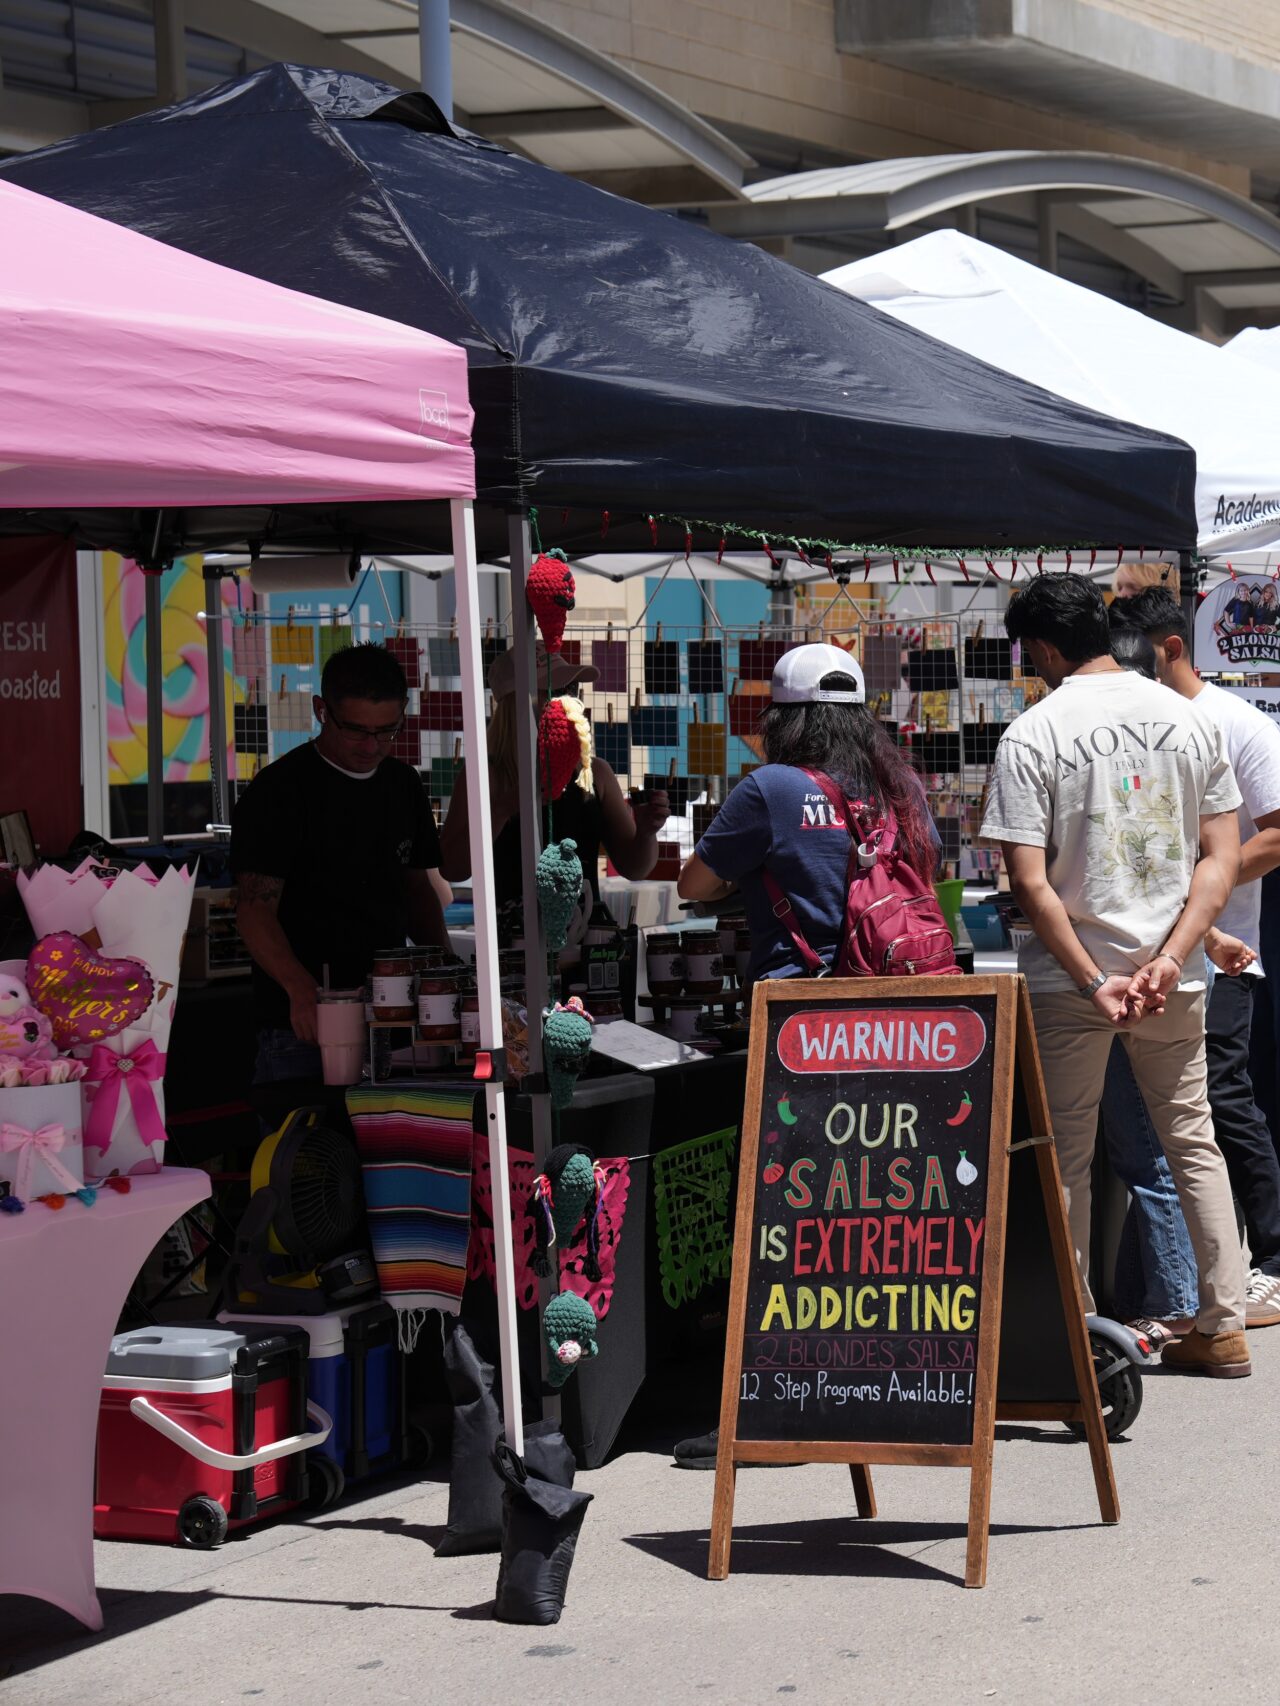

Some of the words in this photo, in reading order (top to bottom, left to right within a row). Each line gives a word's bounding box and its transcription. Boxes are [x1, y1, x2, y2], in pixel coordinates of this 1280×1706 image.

[0, 621, 47, 652] ESH
[1219, 641, 1230, 651] 2
[1230, 647, 1280, 662] SALSA
[0, 669, 61, 700] oasted
[1055, 722, 1202, 782] MONZA
[1114, 758, 1146, 771] ITALY
[72, 956, 116, 977] HAPPY
[53, 1016, 80, 1032] DAY
[798, 1021, 957, 1062] WARNING
[825, 1102, 919, 1149] OUR
[784, 1155, 950, 1211] SALSA
[759, 1225, 788, 1262] IS
[794, 1215, 986, 1276] EXTREMELY
[759, 1283, 977, 1332] ADDICTING
[754, 1337, 782, 1366] 2
[788, 1337, 896, 1369] BLONDES
[906, 1338, 976, 1369] SALSA
[740, 1373, 760, 1400] 12
[774, 1372, 811, 1411] Step
[816, 1370, 881, 1405] Programs
[887, 1370, 974, 1405] Available!
